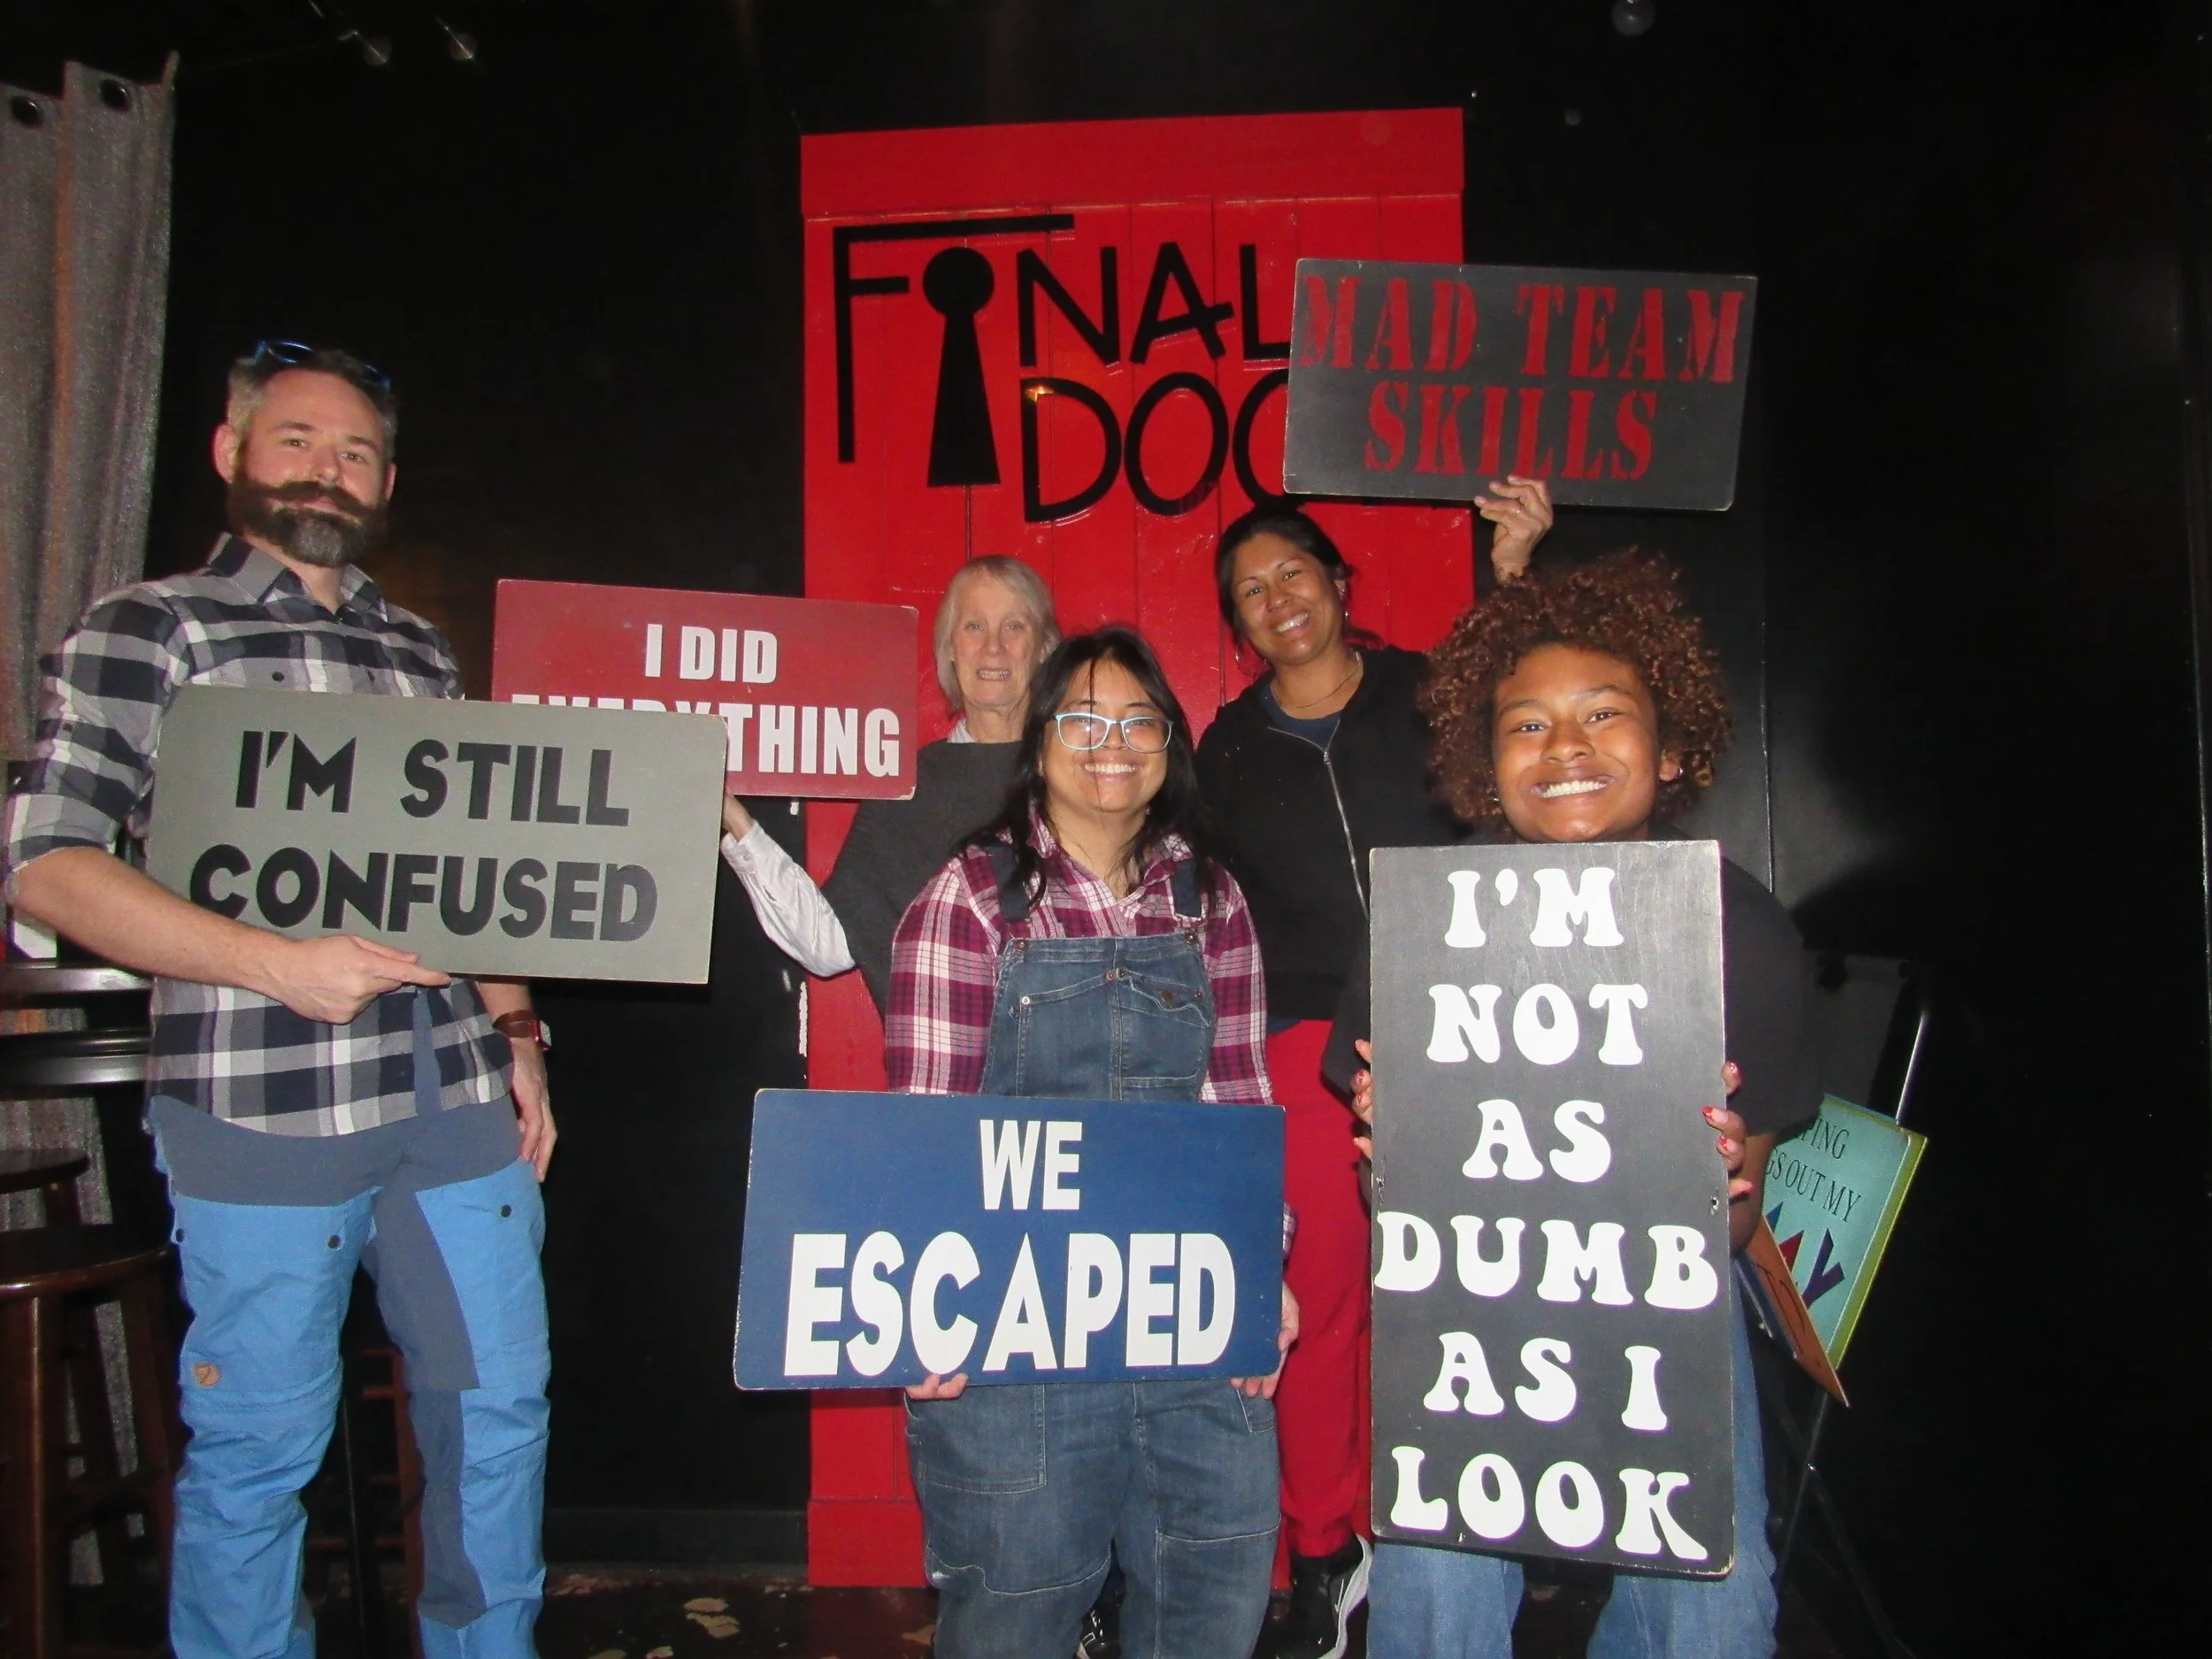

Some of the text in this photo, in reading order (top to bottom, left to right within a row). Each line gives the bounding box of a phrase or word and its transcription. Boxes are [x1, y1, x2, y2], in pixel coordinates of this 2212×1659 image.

[1298, 275, 1746, 383] MAD TEAM
[1364, 380, 1657, 480] SKILLS
[644, 623, 779, 684] I DID
[234, 730, 630, 826] I'M STILL
[511, 694, 900, 776] THING
[188, 843, 658, 942] CONFUSED
[1444, 867, 1624, 948] I'M
[1426, 983, 1648, 1065] NOT
[979, 1118, 1083, 1211] WE
[1462, 1099, 1612, 1183] AS
[1785, 1159, 1826, 1202] OUT
[1823, 1180, 1862, 1223] MY
[784, 1231, 1236, 1377] ESCAPED
[1374, 1211, 1718, 1310] DUMB
[1423, 1332, 1668, 1432] AS I
[1390, 1446, 1708, 1560] LOOK
